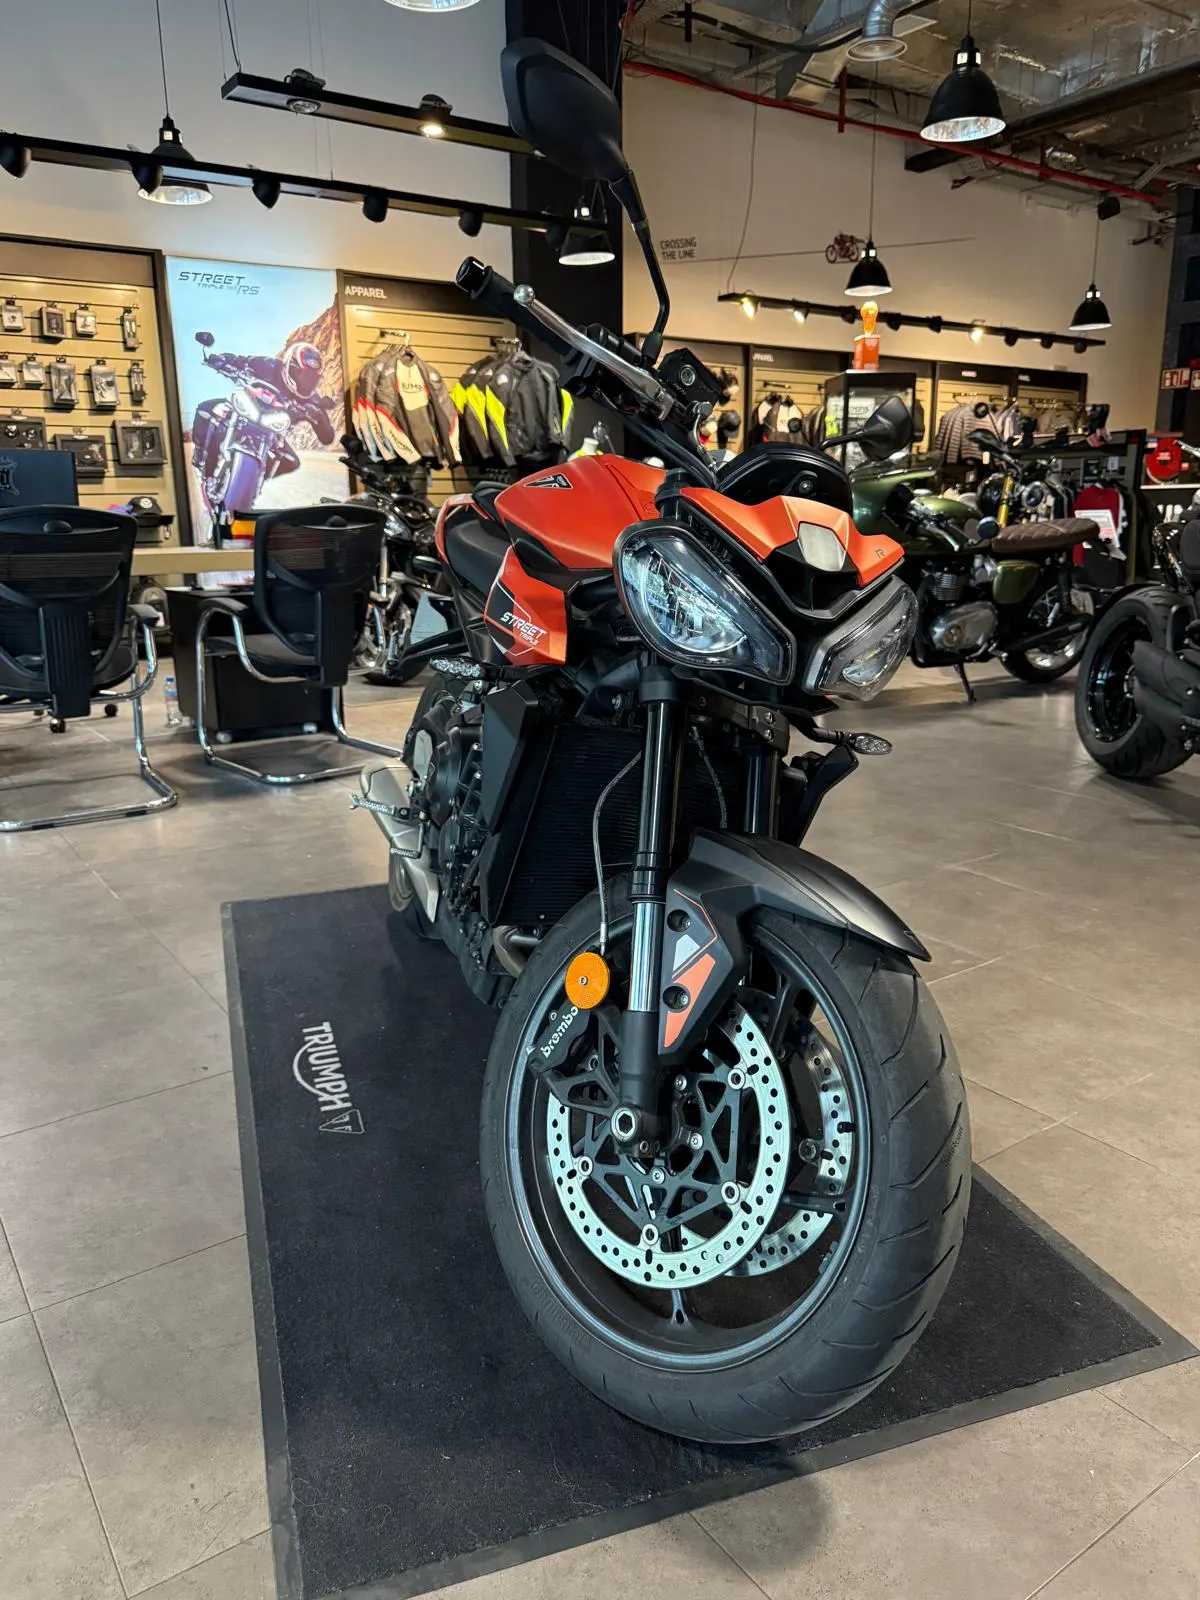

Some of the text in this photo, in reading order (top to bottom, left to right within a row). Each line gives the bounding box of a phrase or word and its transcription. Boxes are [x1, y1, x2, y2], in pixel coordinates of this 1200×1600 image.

[660, 236, 697, 250] CROSSING
[661, 249, 696, 260] THE LINE
[178, 271, 246, 286] STREET
[237, 285, 261, 295] RS
[345, 285, 388, 299] APPAREL
[500, 611, 548, 639] STREET
[540, 1006, 579, 1058] brembo
[293, 1021, 352, 1112] TRIUMPH
